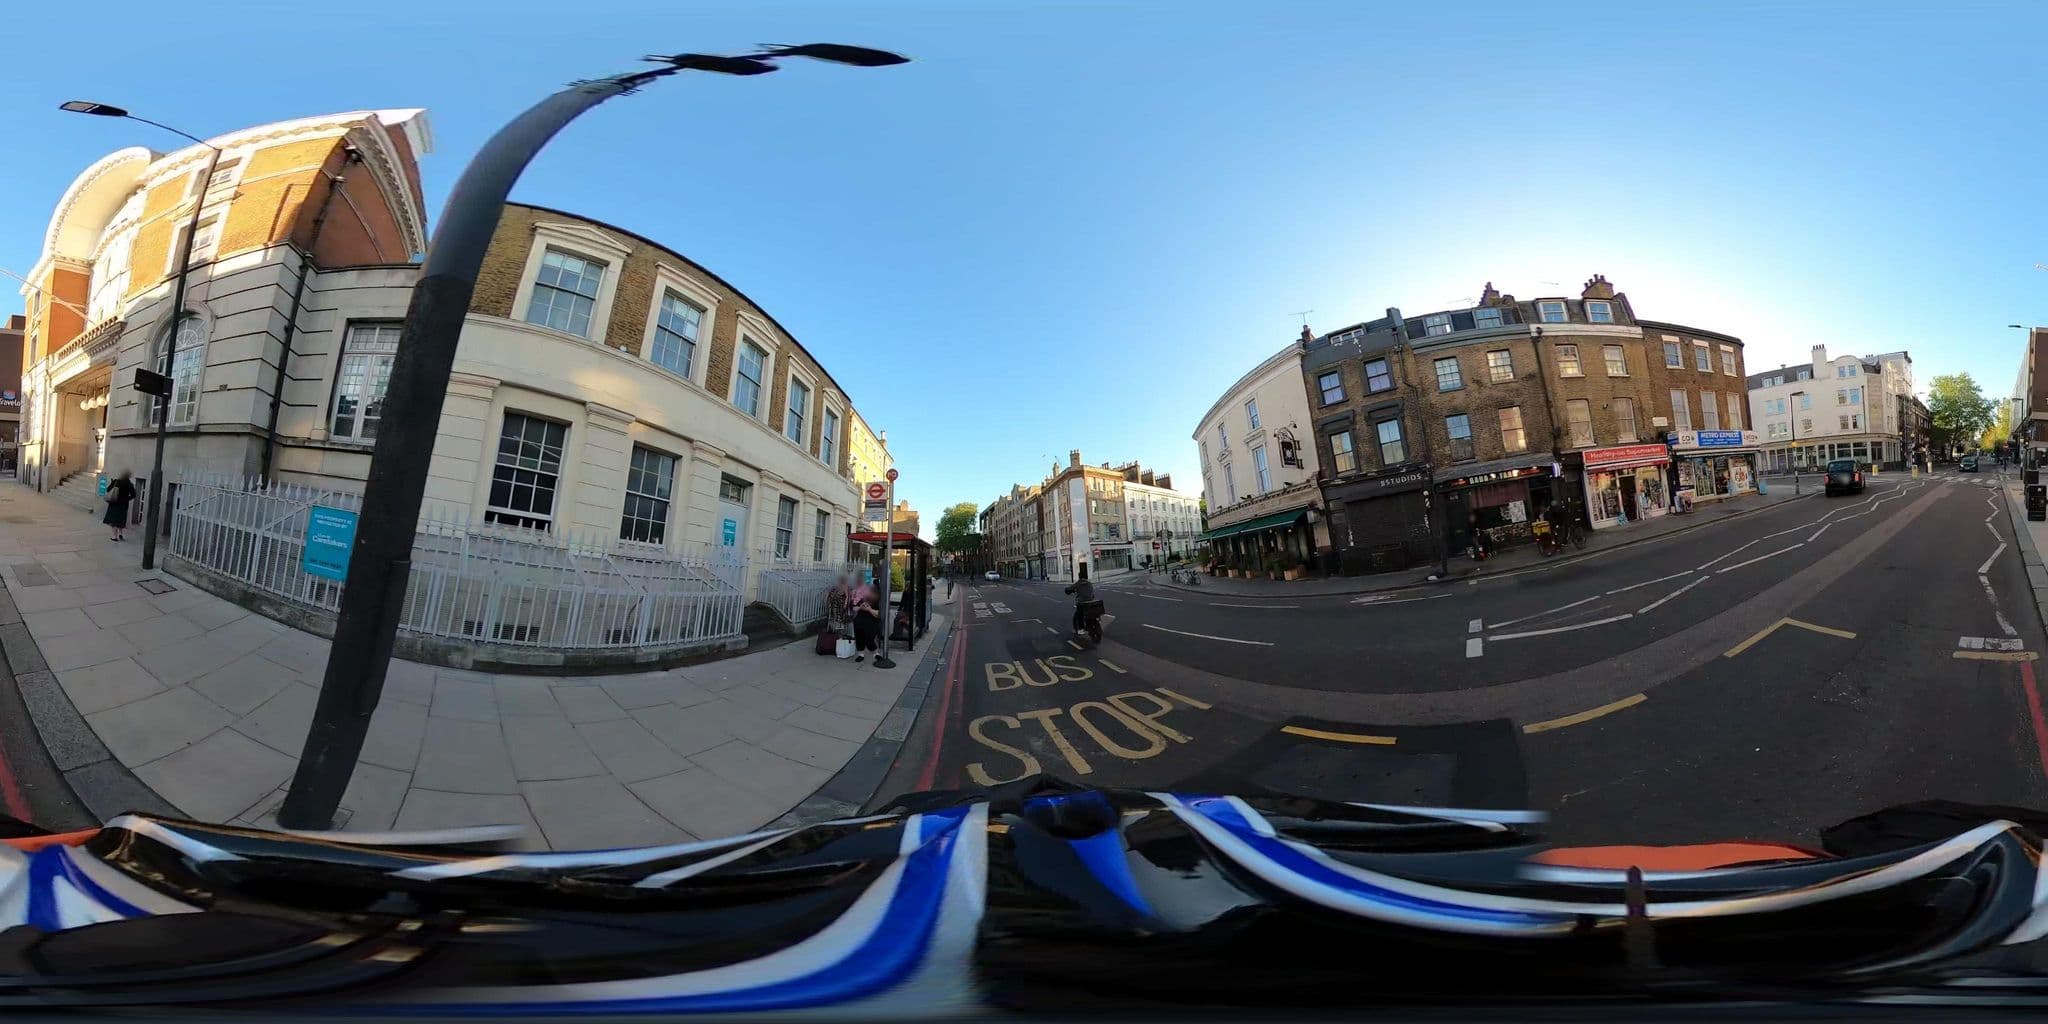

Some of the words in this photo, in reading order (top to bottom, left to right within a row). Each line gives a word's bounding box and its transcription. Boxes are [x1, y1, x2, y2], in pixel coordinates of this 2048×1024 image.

[0, 398, 20, 407] ravelo
[984, 655, 1094, 692] BUS
[966, 691, 1194, 787] STOP
